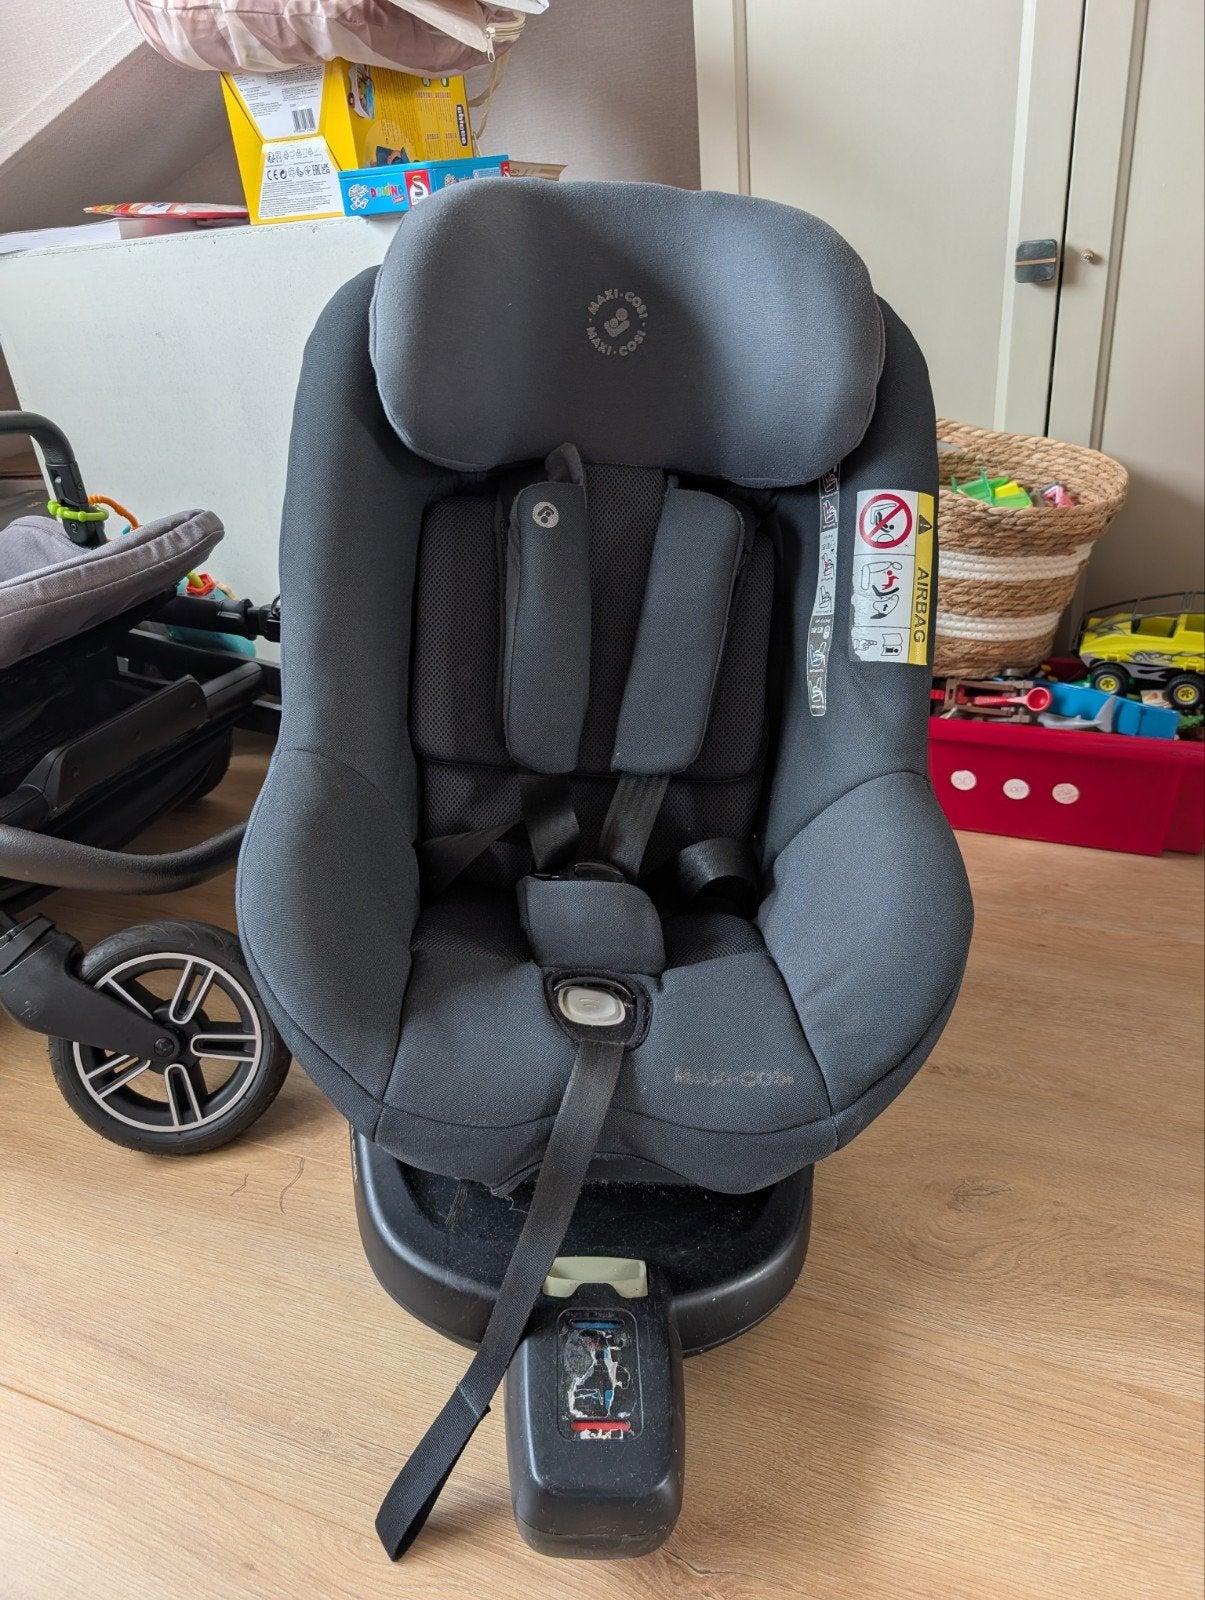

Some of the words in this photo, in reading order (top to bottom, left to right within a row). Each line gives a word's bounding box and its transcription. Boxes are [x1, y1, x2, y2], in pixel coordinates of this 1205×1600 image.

[588, 288, 618, 315] MAXI
[624, 291, 649, 318] COSI
[586, 326, 612, 356] MAXI
[619, 330, 646, 356] COSI
[913, 566, 929, 643] AIRBAG
